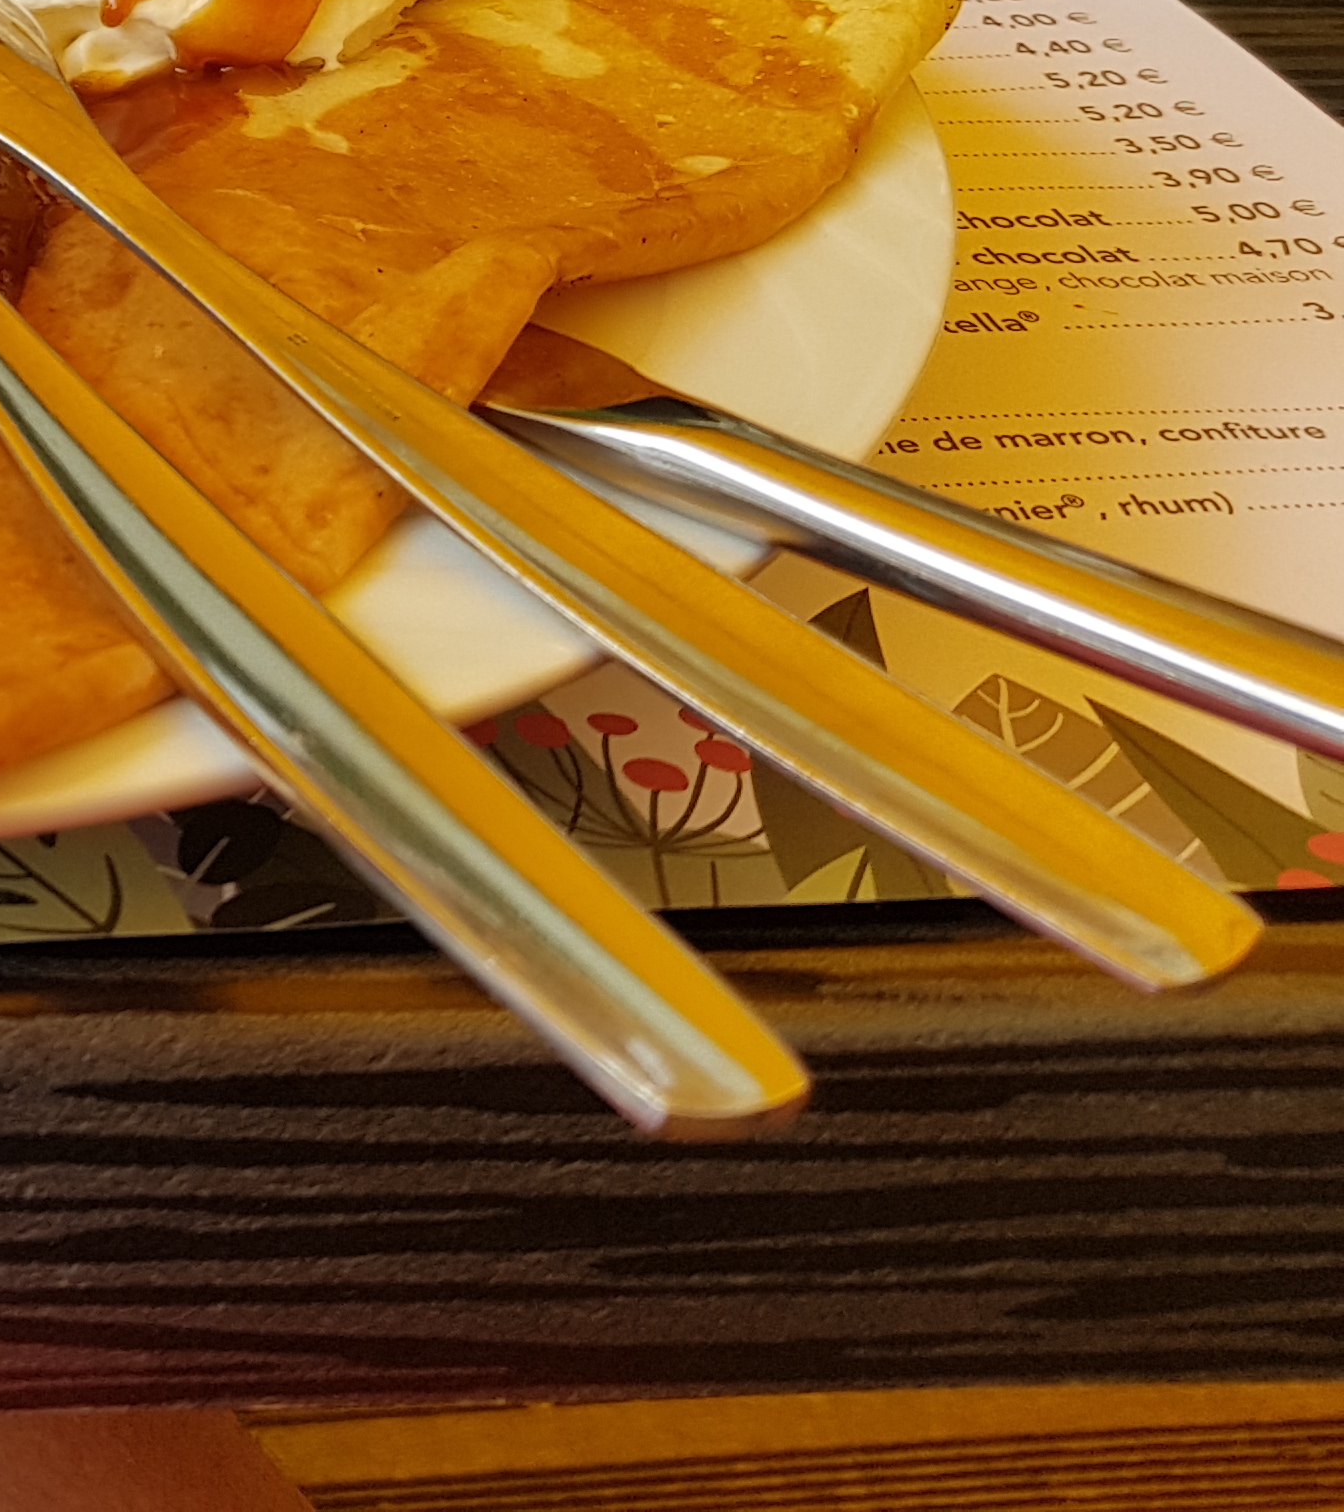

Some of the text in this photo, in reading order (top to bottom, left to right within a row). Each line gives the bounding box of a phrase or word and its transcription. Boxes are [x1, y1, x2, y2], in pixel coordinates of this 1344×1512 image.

[981, 13, 1058, 29] 4,00
[1015, 39, 1092, 58] 4,40
[1042, 69, 1128, 91] 5,20
[1078, 102, 1164, 123] 5,20
[1114, 133, 1202, 155] 3,50
[1152, 166, 1241, 189] 3,90
[1190, 200, 1282, 225] 5,00
[971, 244, 1140, 266] chocolat
[1238, 237, 1324, 260] 4,70
[1058, 270, 1204, 290] chocolat
[1209, 267, 1333, 285] maison
[933, 430, 983, 452] de
[994, 426, 1148, 448] marron,
[1158, 422, 1326, 444] confiture
[1117, 490, 1235, 517] rhum)
